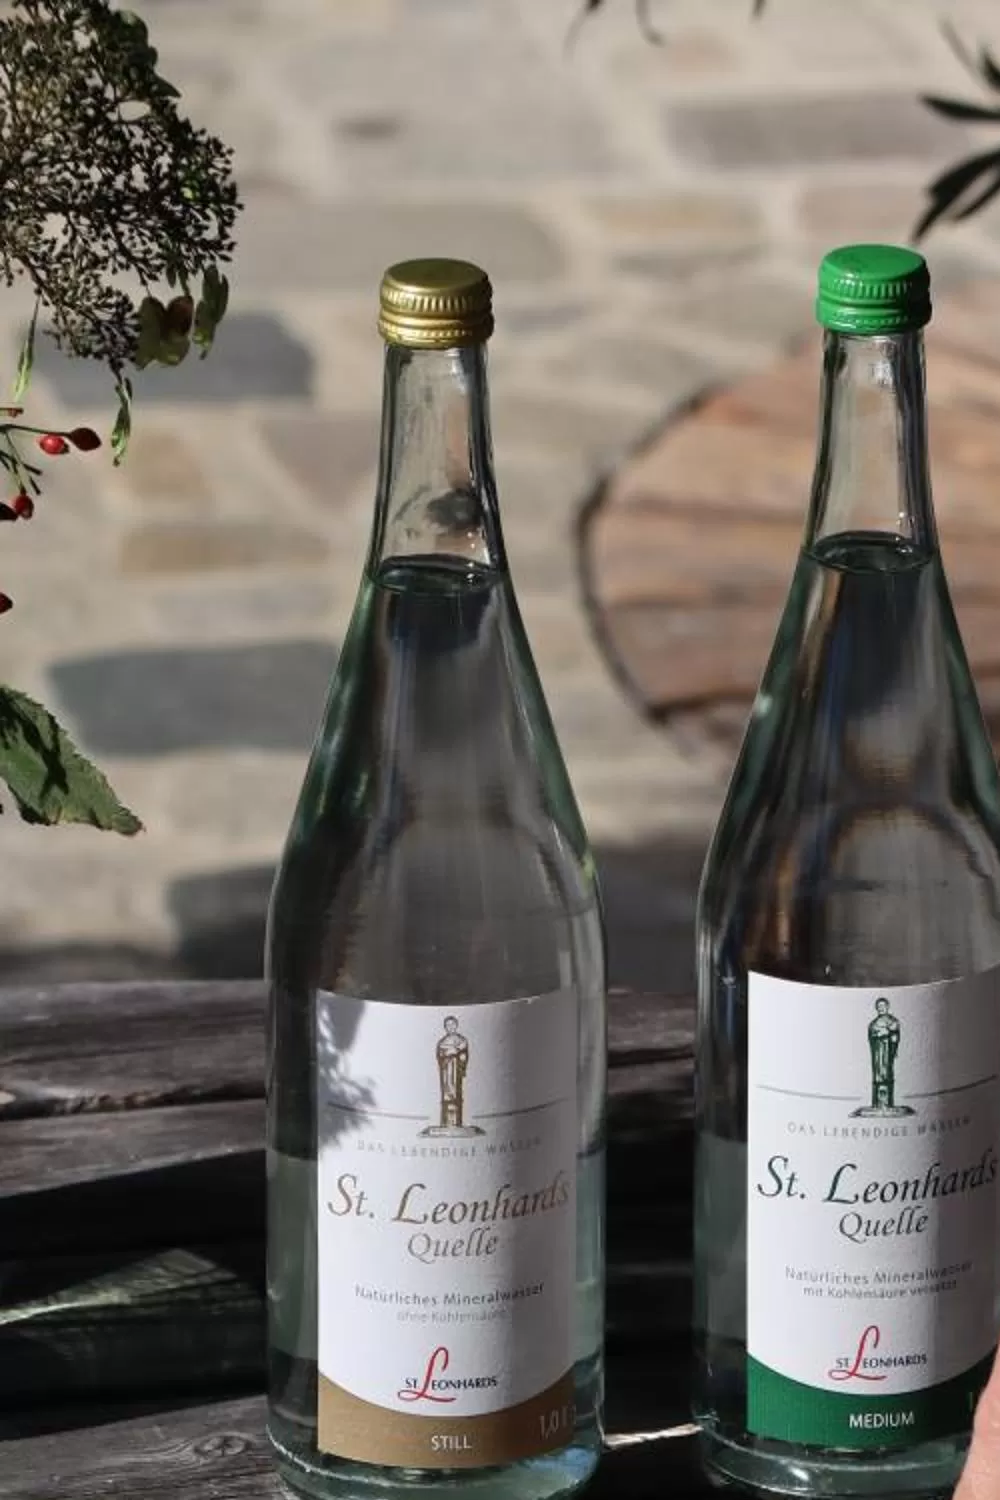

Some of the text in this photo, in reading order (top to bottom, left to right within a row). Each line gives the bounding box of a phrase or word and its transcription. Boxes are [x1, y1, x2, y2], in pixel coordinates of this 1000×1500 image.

[788, 1121, 816, 1136] DAS
[757, 1148, 999, 1206] St. Leonhards
[327, 1168, 572, 1226] St. Leonhards
[838, 1206, 930, 1245] Quelle
[406, 1226, 499, 1265] Quelle
[848, 1412, 915, 1429] MEDIUM
[431, 1434, 473, 1451] STILL
